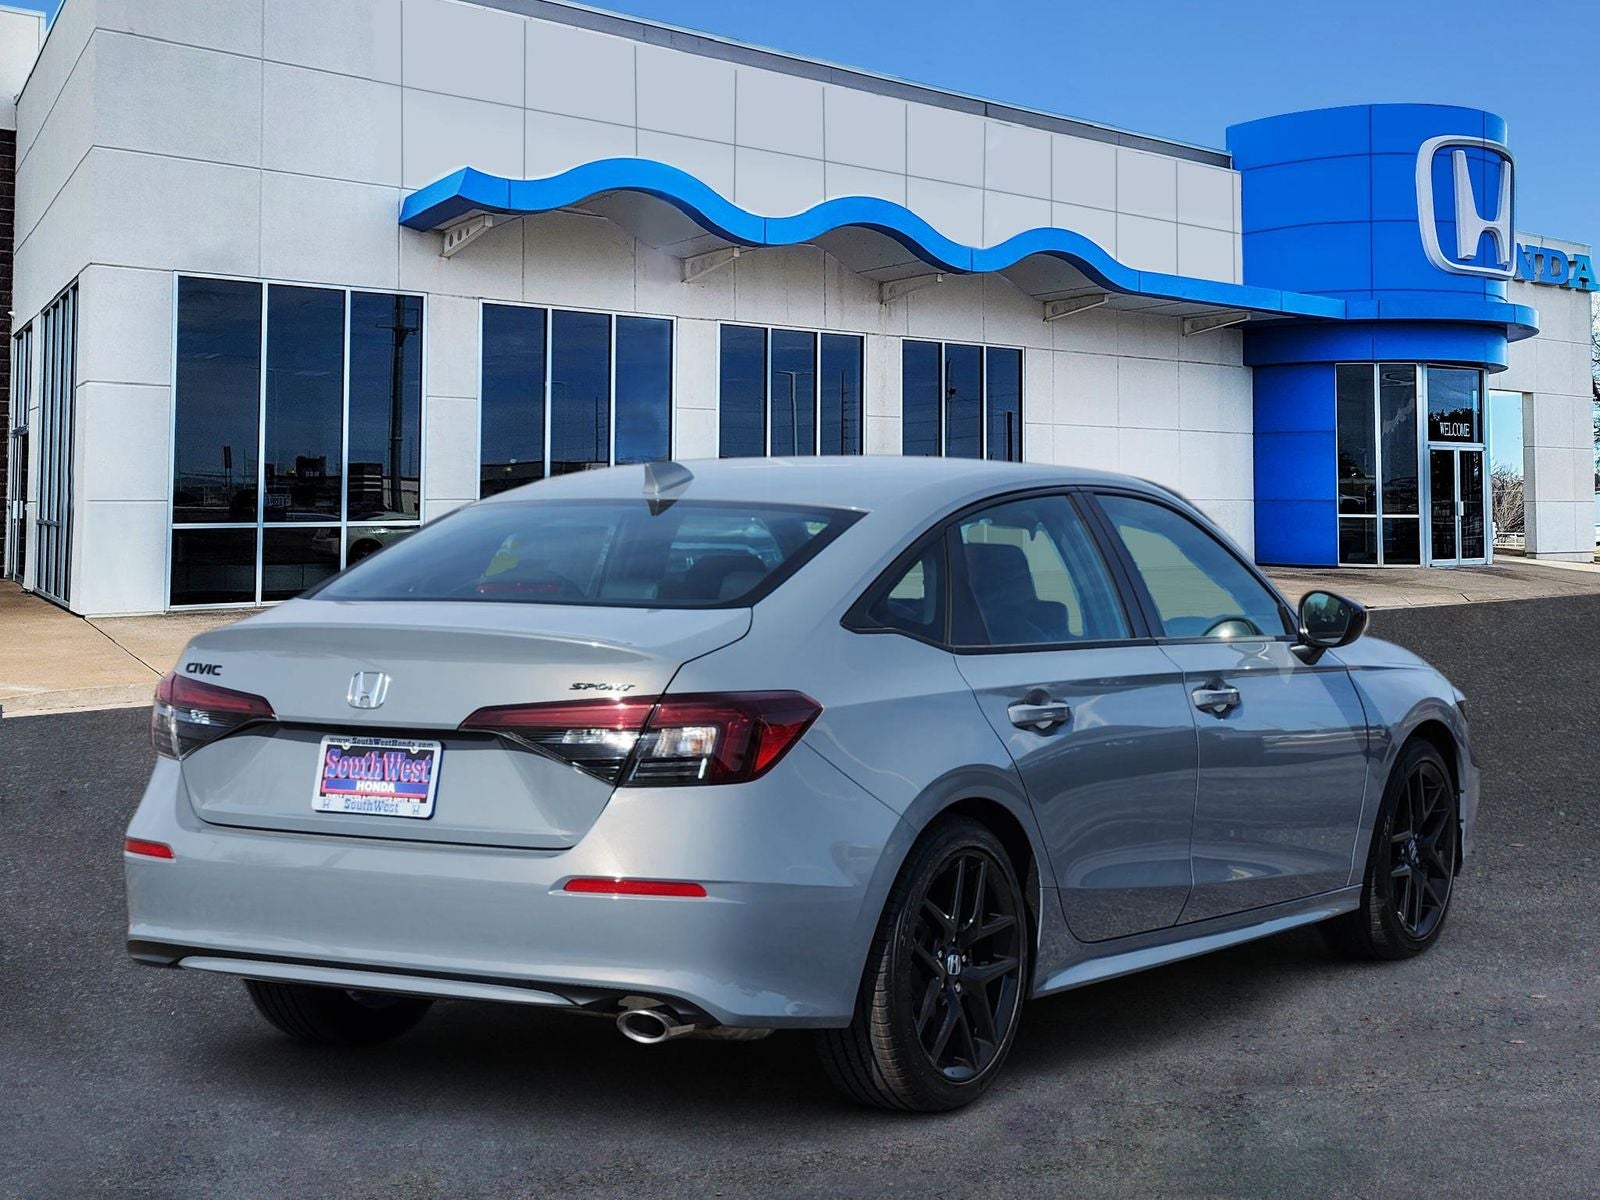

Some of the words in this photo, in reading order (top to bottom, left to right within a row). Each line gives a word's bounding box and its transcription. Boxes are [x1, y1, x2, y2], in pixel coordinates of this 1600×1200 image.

[1440, 422, 1471, 437] WELCOME
[186, 662, 223, 676] CIVIC
[569, 682, 636, 692] SPORT
[356, 780, 395, 792] HONDA
